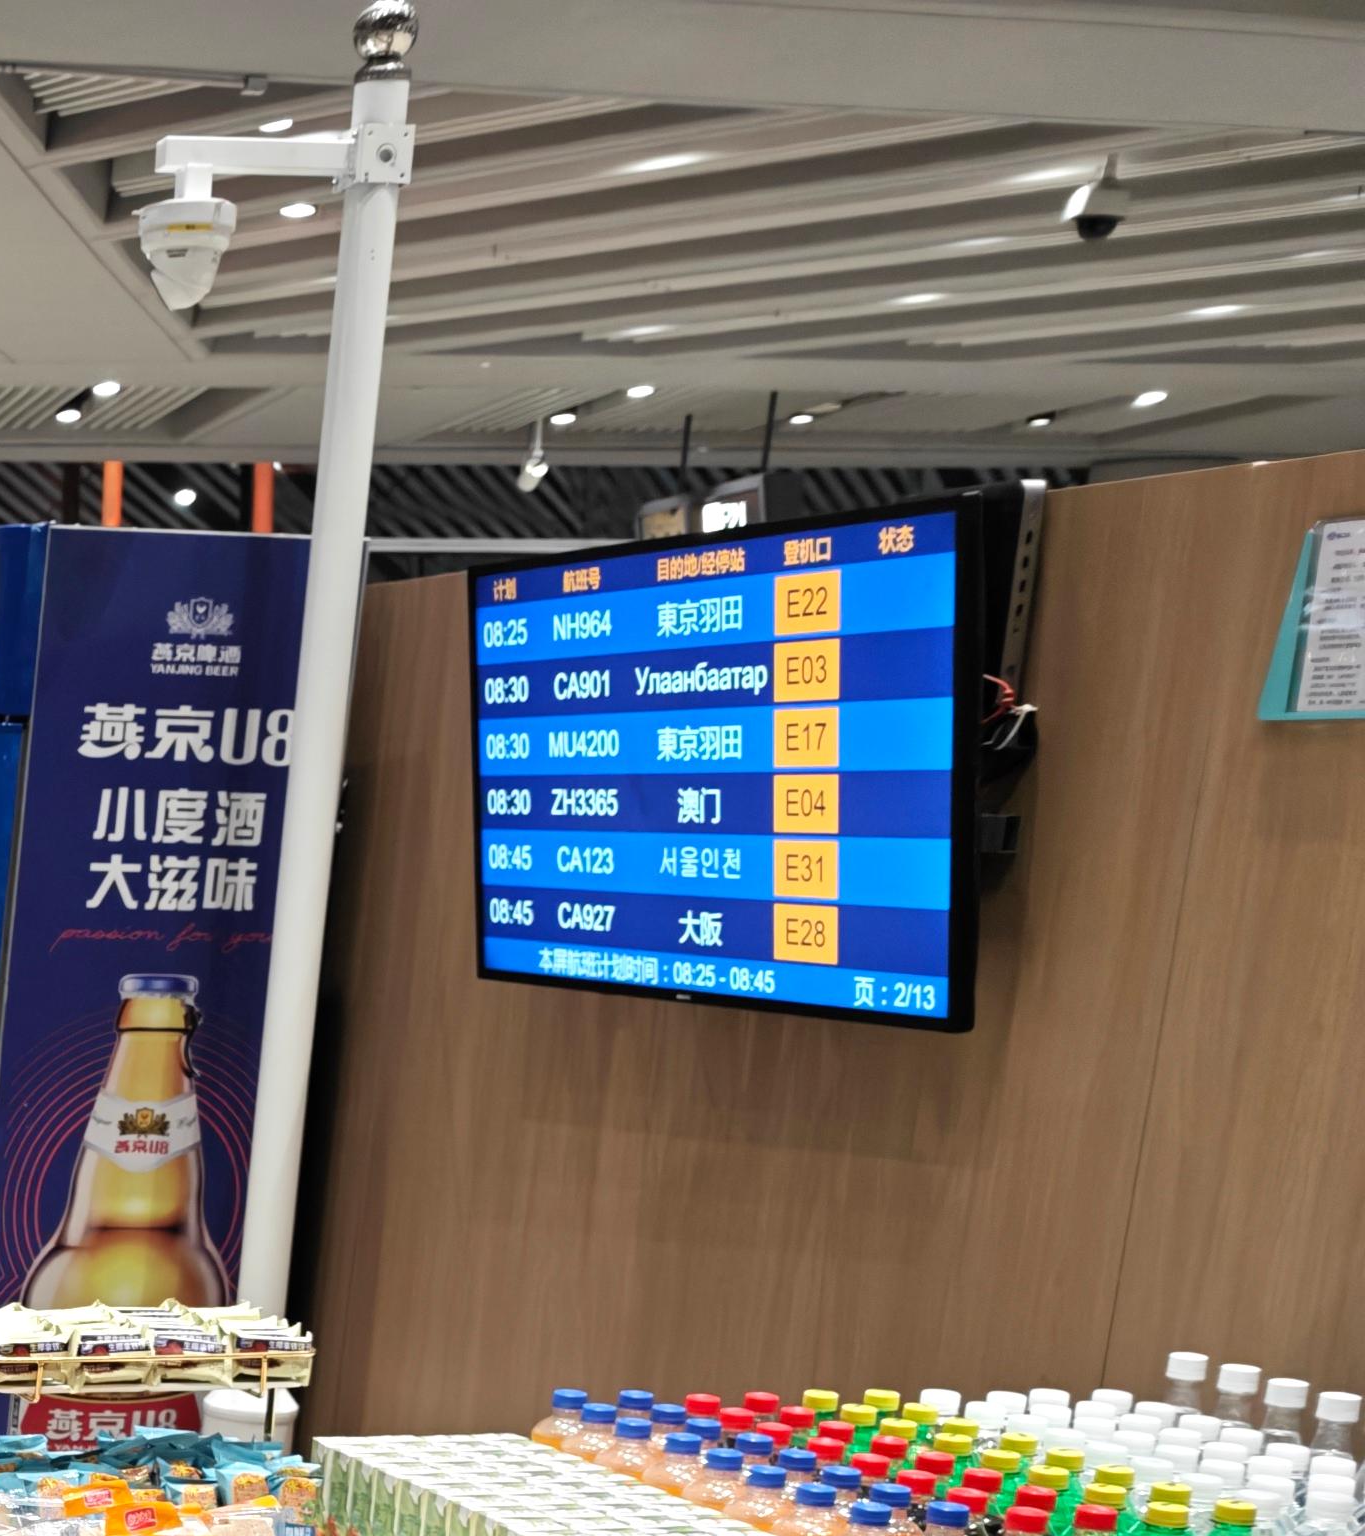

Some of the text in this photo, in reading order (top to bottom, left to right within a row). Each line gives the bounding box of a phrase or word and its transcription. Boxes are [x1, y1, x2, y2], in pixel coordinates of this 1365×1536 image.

[784, 536, 832, 565] 登机口
[879, 525, 915, 554] 状态
[563, 567, 601, 592] 航班号
[657, 548, 745, 582] 目的地/经停站
[493, 580, 516, 601] 计划
[483, 586, 828, 648] 08:25 NH964 東京羽田 E22
[150, 663, 239, 677] YANJING BEER
[151, 642, 242, 664] 燕京啤酒
[484, 654, 828, 704] 08:30 CA901 Улаанбаатар E03
[77, 702, 295, 768] 燕京U8
[486, 722, 827, 763] 08:30 MU4200 東京羽田 E17
[92, 786, 267, 847] 小度酒
[487, 787, 827, 825] 08:30 ZH3365 澳门 E04
[85, 853, 259, 912] 大滋味
[488, 843, 826, 884] 08:45 CA123 서울인천 E31
[489, 897, 826, 949] 08:45 CA927 大阪 E28
[114, 1140, 171, 1155] 燕京U8
